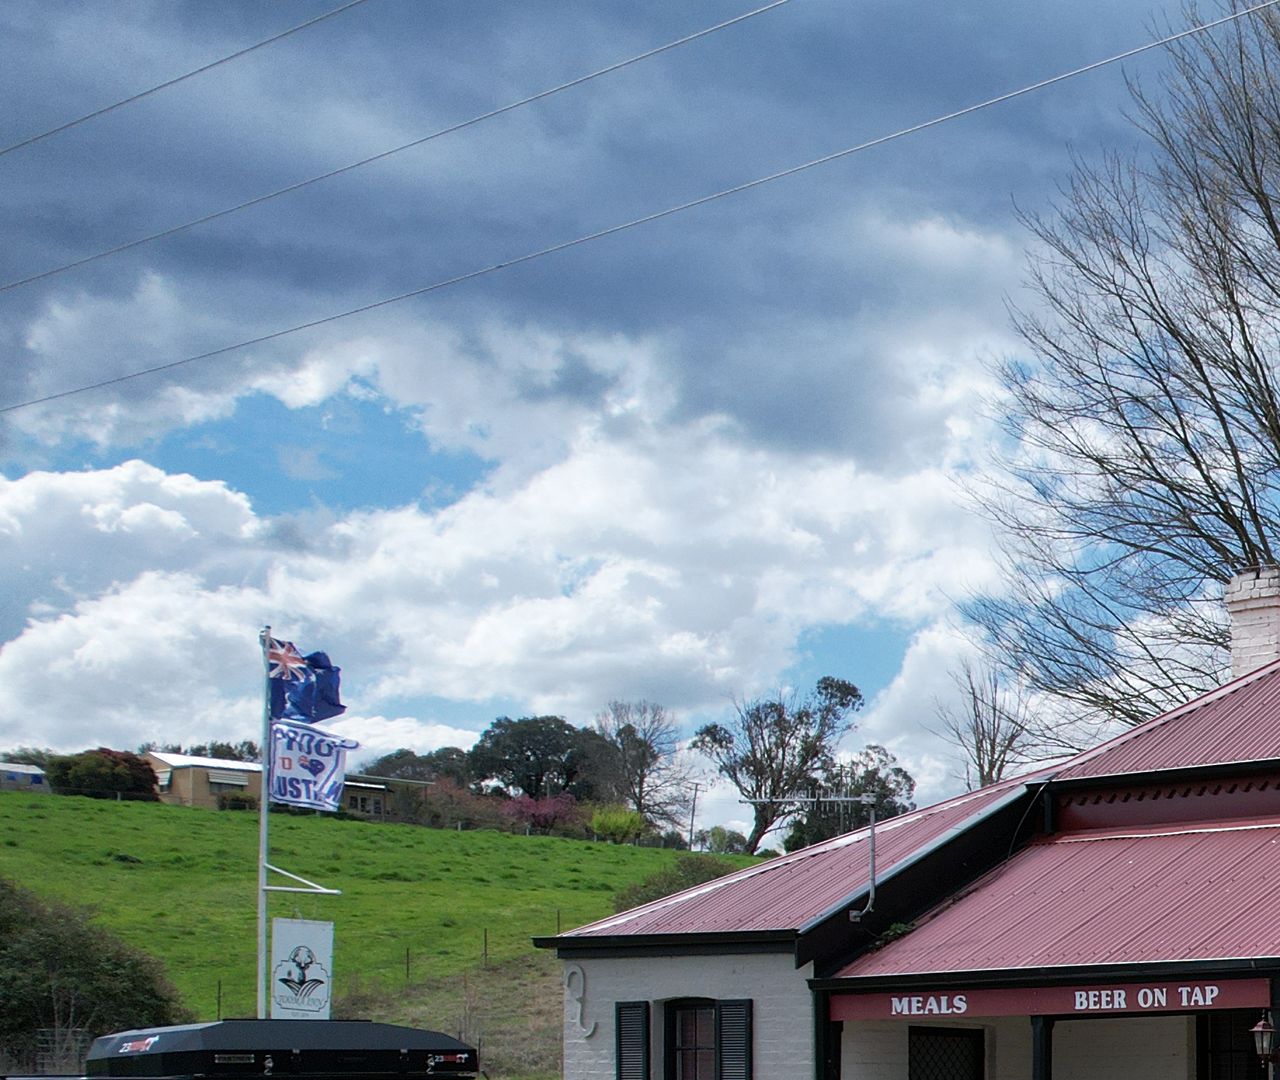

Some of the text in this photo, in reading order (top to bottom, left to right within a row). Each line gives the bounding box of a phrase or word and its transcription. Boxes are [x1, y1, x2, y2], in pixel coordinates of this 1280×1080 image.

[890, 995, 968, 1015] MEALS
[1074, 985, 1220, 1011] BEER ON TAP
